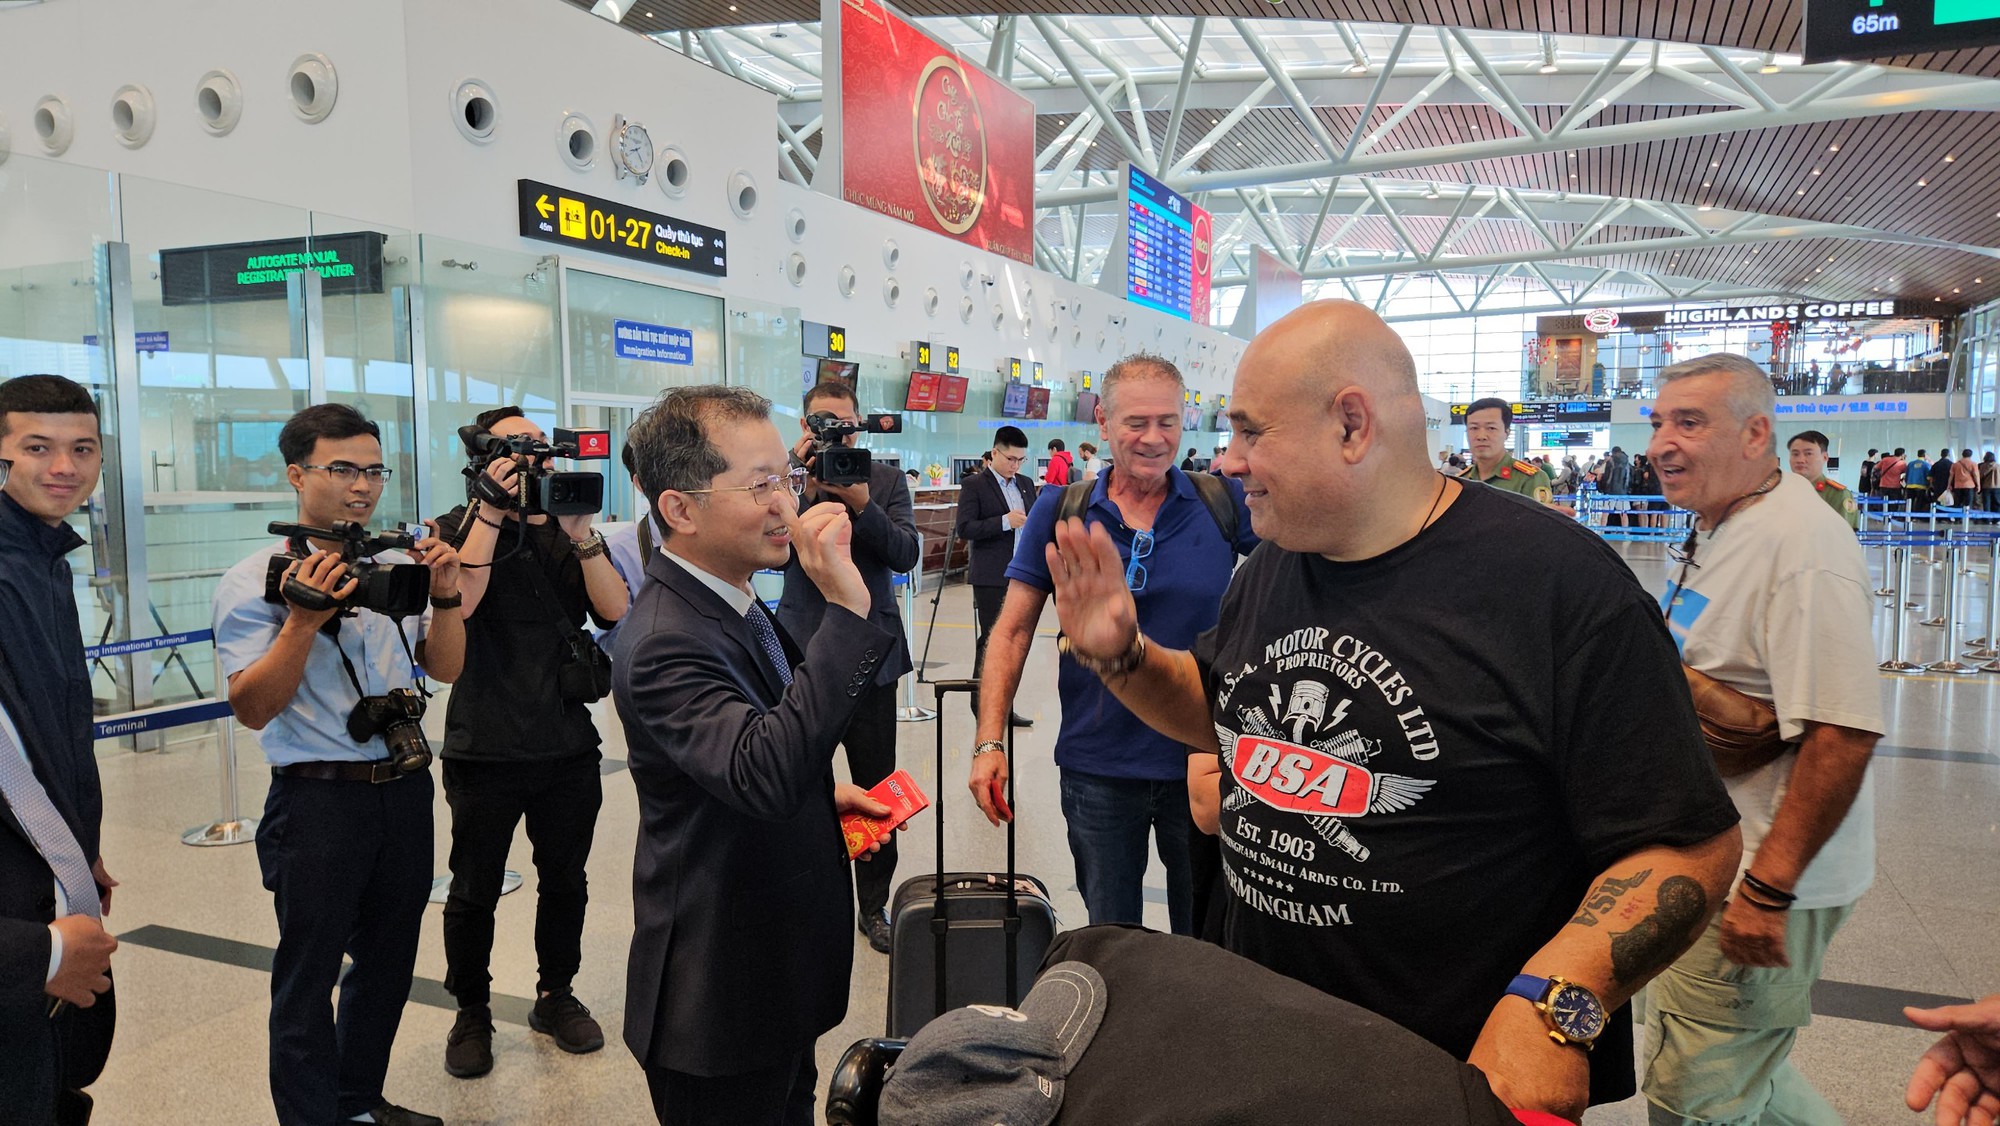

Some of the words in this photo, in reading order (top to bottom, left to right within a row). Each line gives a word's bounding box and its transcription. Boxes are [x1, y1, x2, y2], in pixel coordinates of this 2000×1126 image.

[1852, 14, 1898, 34] 65m
[590, 209, 651, 250] 01-27
[656, 240, 690, 260] Check-in
[247, 253, 299, 270] AUTOGATE
[237, 268, 304, 285] REGISTRAT
[1664, 306, 1799, 324] HIGHLANDS
[1804, 301, 1895, 318] COFFEE
[624, 344, 656, 358] Immigration
[830, 332, 844, 352] 30
[919, 346, 929, 364] 31
[948, 352, 958, 368] 32
[85, 649, 99, 658] ang
[102, 640, 153, 655] International
[155, 635, 187, 649] Terminal
[1276, 652, 1367, 689] PROPRIETORS
[1218, 663, 1258, 712] B.S.A.
[1264, 627, 1329, 665] MOTOR
[1332, 634, 1413, 706] CYCLES
[1397, 705, 1440, 761] LTD
[100, 719, 147, 735] Terminal
[1241, 743, 1348, 807] BSA
[1267, 829, 1316, 862] 1903
